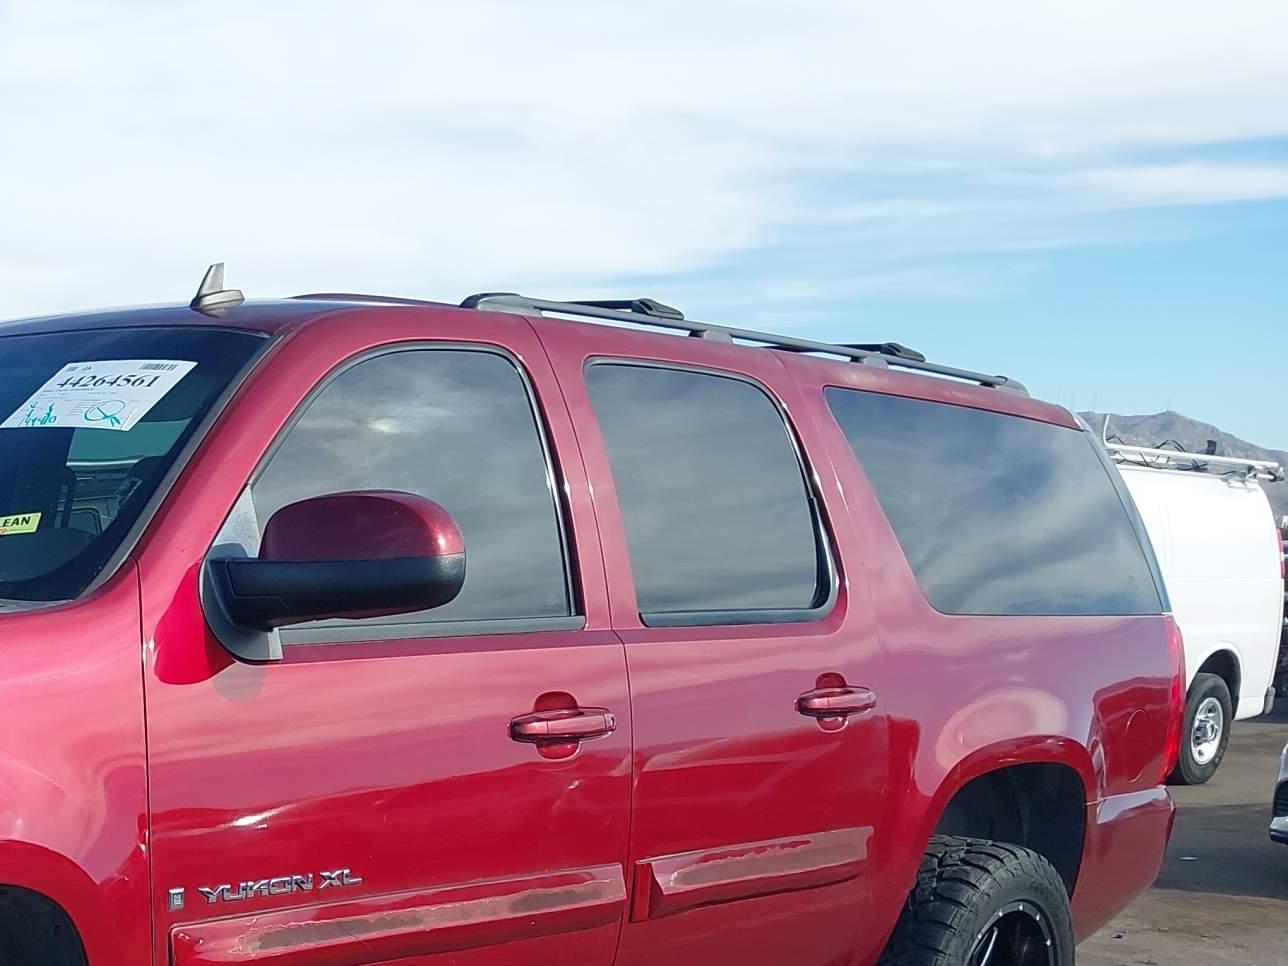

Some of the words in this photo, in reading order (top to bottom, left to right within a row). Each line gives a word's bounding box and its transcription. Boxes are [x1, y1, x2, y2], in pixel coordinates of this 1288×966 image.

[57, 374, 160, 389] 44264561
[198, 873, 313, 904] YUKON
[319, 868, 362, 889] XL
